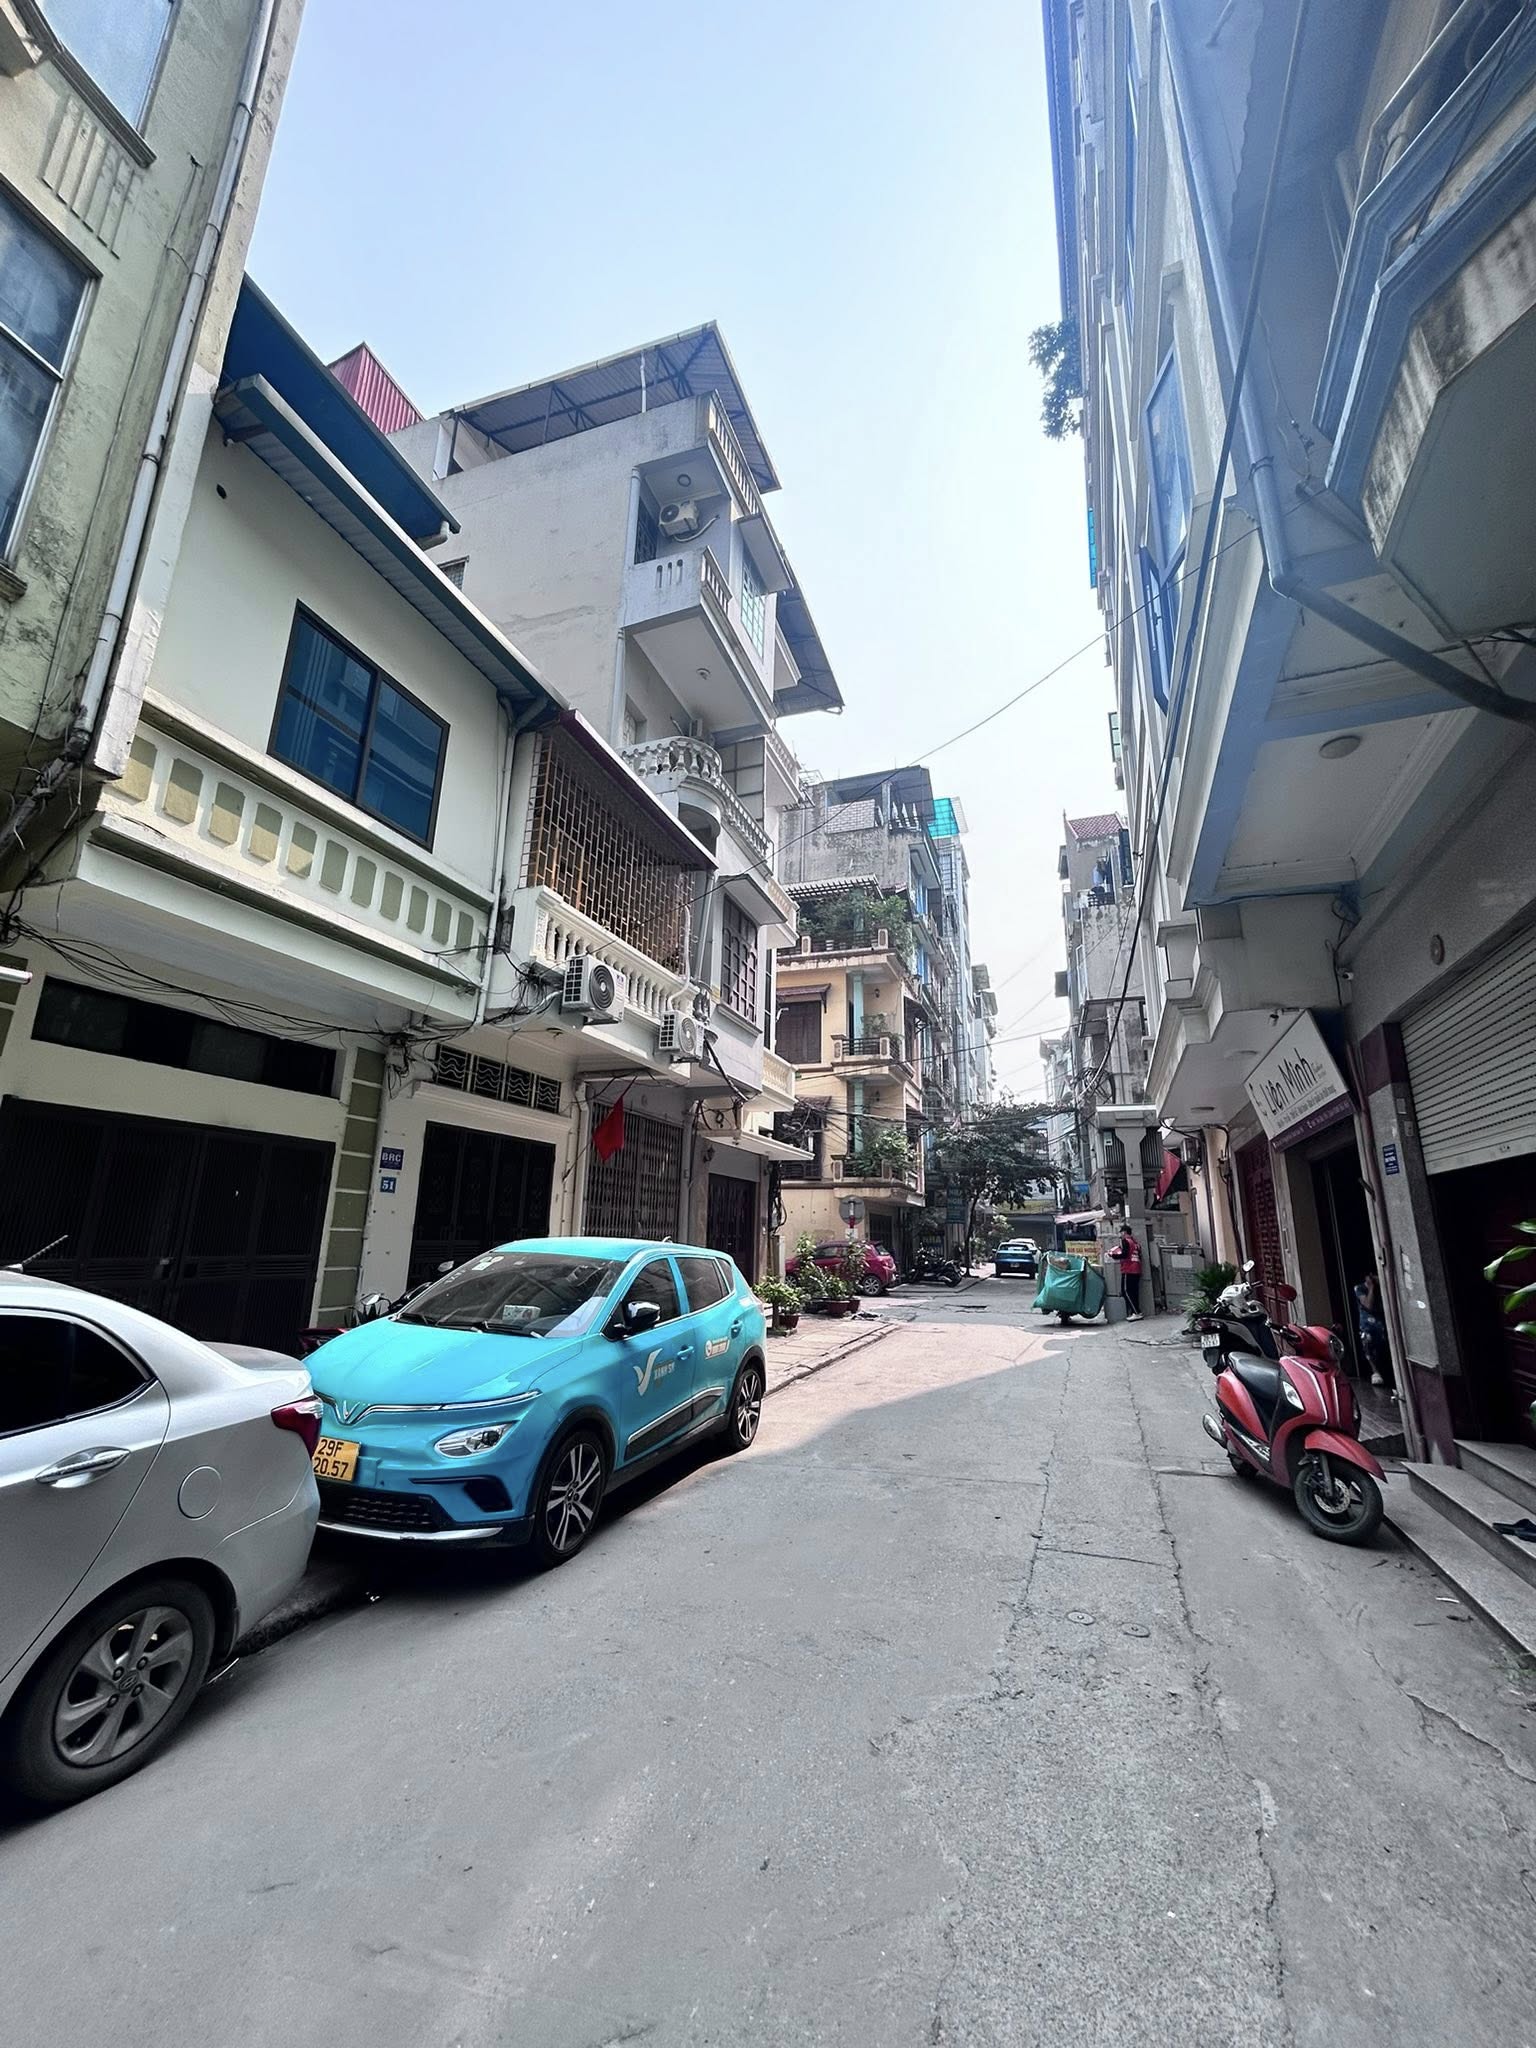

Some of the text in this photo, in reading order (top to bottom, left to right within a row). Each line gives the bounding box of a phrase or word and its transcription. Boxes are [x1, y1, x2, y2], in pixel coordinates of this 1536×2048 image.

[1259, 1079, 1290, 1115] Liên
[1277, 1047, 1318, 1099] Minh
[382, 1152, 401, 1162] BRC
[382, 1180, 394, 1190] 51
[317, 1439, 344, 1457] 29F
[313, 1456, 349, 1478] 20.57
